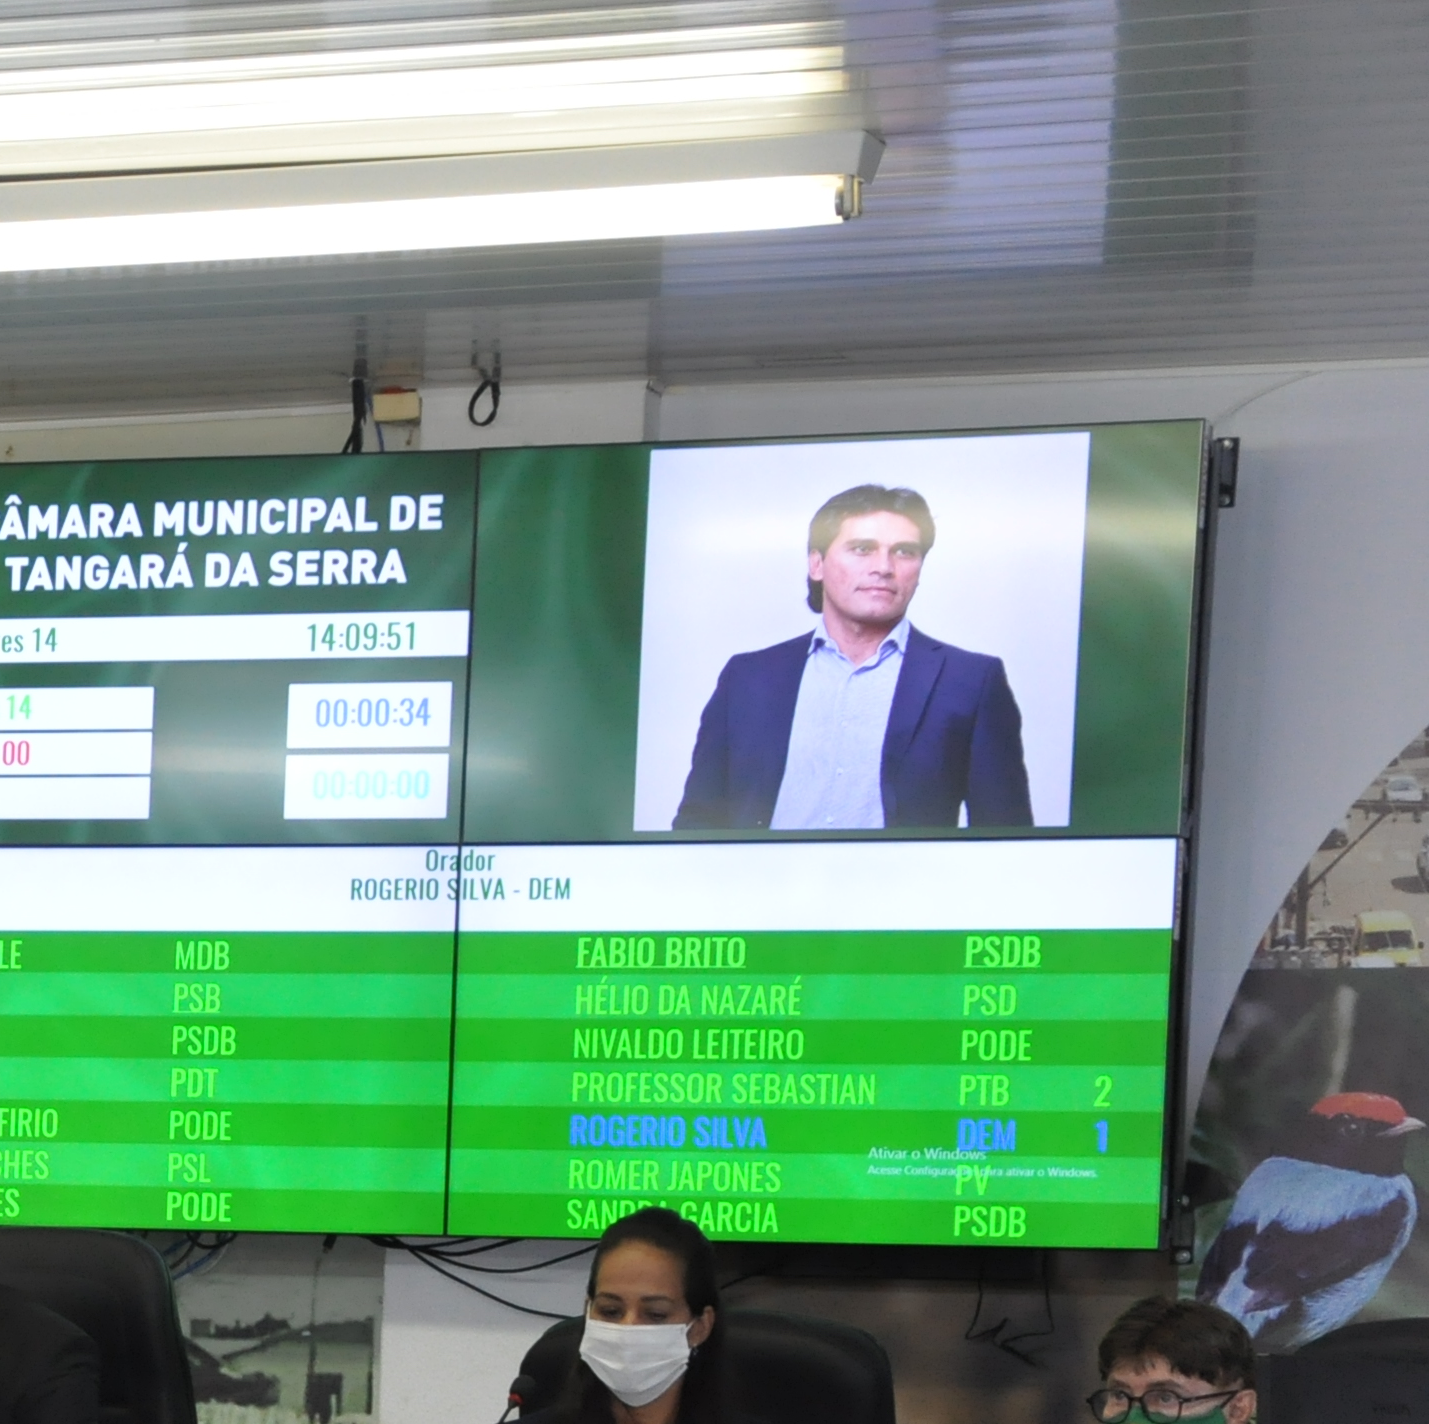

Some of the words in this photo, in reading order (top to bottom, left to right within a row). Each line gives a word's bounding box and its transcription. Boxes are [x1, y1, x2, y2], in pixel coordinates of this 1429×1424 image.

[152, 498, 379, 537] MUNICIPAL
[389, 494, 444, 531] DE
[5, 543, 194, 592] TANGARÁ
[203, 553, 261, 588] DA
[267, 548, 407, 587] SERRA
[32, 627, 58, 652] 14
[306, 621, 417, 653] 14:09:51
[6, 694, 32, 720] 14
[314, 697, 431, 728] 00:00:34
[2, 740, 31, 766] 00
[312, 769, 430, 801] 00:00:00
[426, 849, 496, 872] Orador
[351, 878, 439, 901] ROGERIO
[447, 877, 505, 901] SILVA
[529, 877, 571, 900] DEM
[175, 941, 231, 971] MDB
[576, 936, 657, 968] FABIO
[665, 937, 747, 968] BRITO
[965, 936, 1042, 968] PSDB
[173, 983, 221, 1013] PSB
[575, 976, 649, 1016] HÉLIO
[659, 985, 692, 1015] DA
[700, 975, 802, 1016] NAZARÉ
[963, 985, 1017, 1016] PSD
[172, 1026, 236, 1056] PSDB
[573, 1029, 683, 1060] NIVALDO
[692, 1029, 805, 1061] LEITEIRO
[961, 1030, 1032, 1062] PODE
[170, 1069, 218, 1098] PDT
[571, 1073, 722, 1104] PROFESSOR
[732, 1073, 876, 1105] SEBASTIAN
[959, 1074, 1010, 1106] PTB
[1094, 1075, 1112, 1107] 2
[169, 1111, 232, 1141] PODE
[570, 1115, 685, 1147] ROGERIO
[694, 1116, 768, 1148] SILVA
[957, 1118, 1016, 1151] DEM
[1095, 1120, 1109, 1152] 1
[168, 1152, 211, 1183] PSL
[867, 1147, 907, 1160] Ativar
[911, 1150, 921, 1160] o
[924, 1147, 987, 1161] Windows
[568, 1159, 660, 1190] ROMER
[667, 1160, 782, 1193] JAPONES
[867, 1165, 902, 1176] Acesse
[904, 1165, 975, 1178] Configuraçe
[1005, 1165, 1035, 1177] ativar
[1037, 1168, 1045, 1177] o
[954, 1164, 991, 1196] PV
[167, 1191, 232, 1223] PODE
[567, 1199, 668, 1230] SAND
[681, 1201, 779, 1233] GARCIA
[954, 1206, 1027, 1238] PSDB
